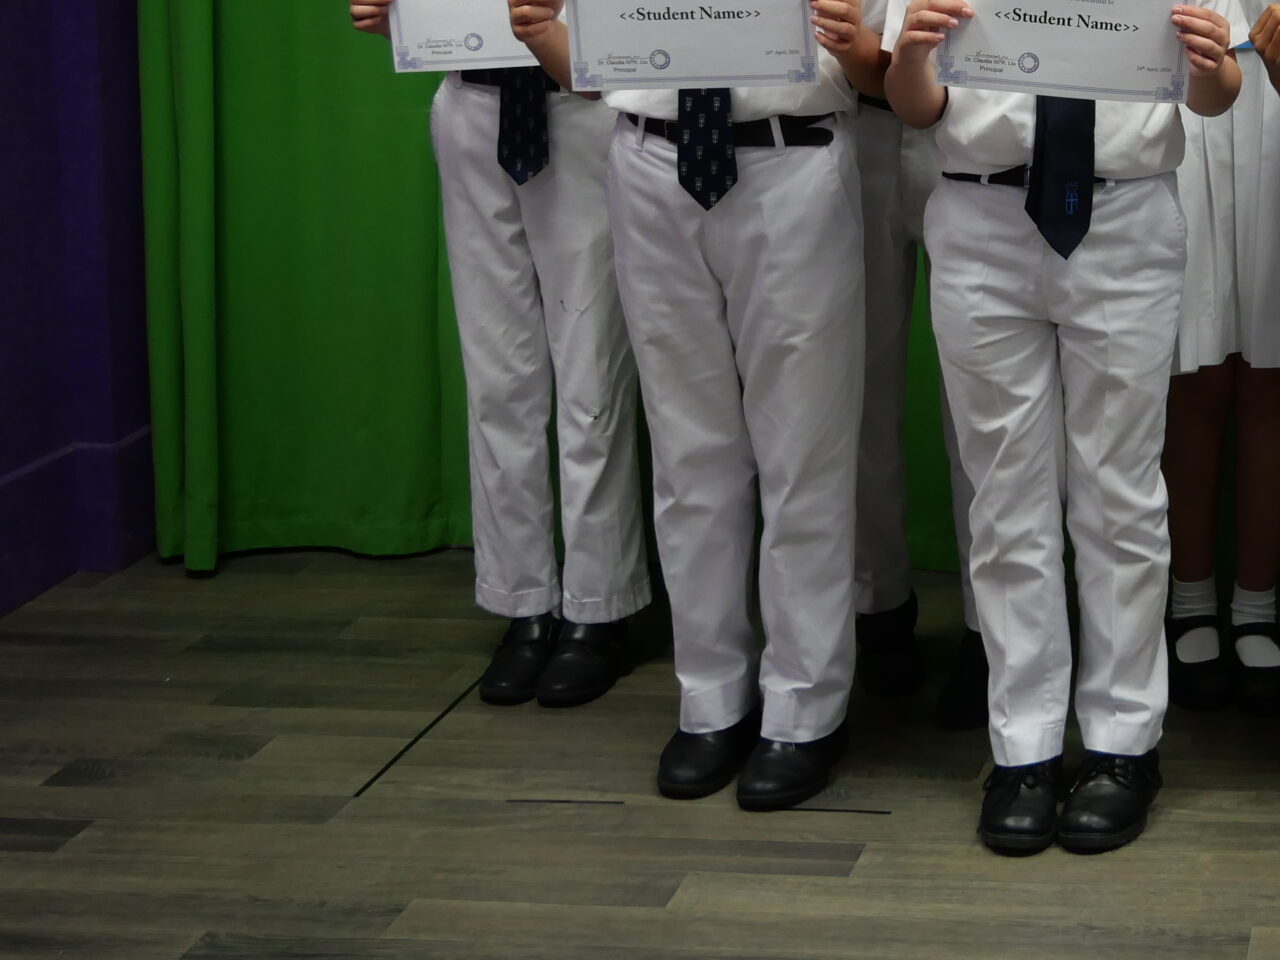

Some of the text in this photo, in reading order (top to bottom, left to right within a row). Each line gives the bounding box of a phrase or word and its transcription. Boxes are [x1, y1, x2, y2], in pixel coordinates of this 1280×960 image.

[620, 6, 760, 20] <<Student Name>>
[995, 8, 1139, 32] <<Student Name>>
[979, 65, 1003, 73] Principal
